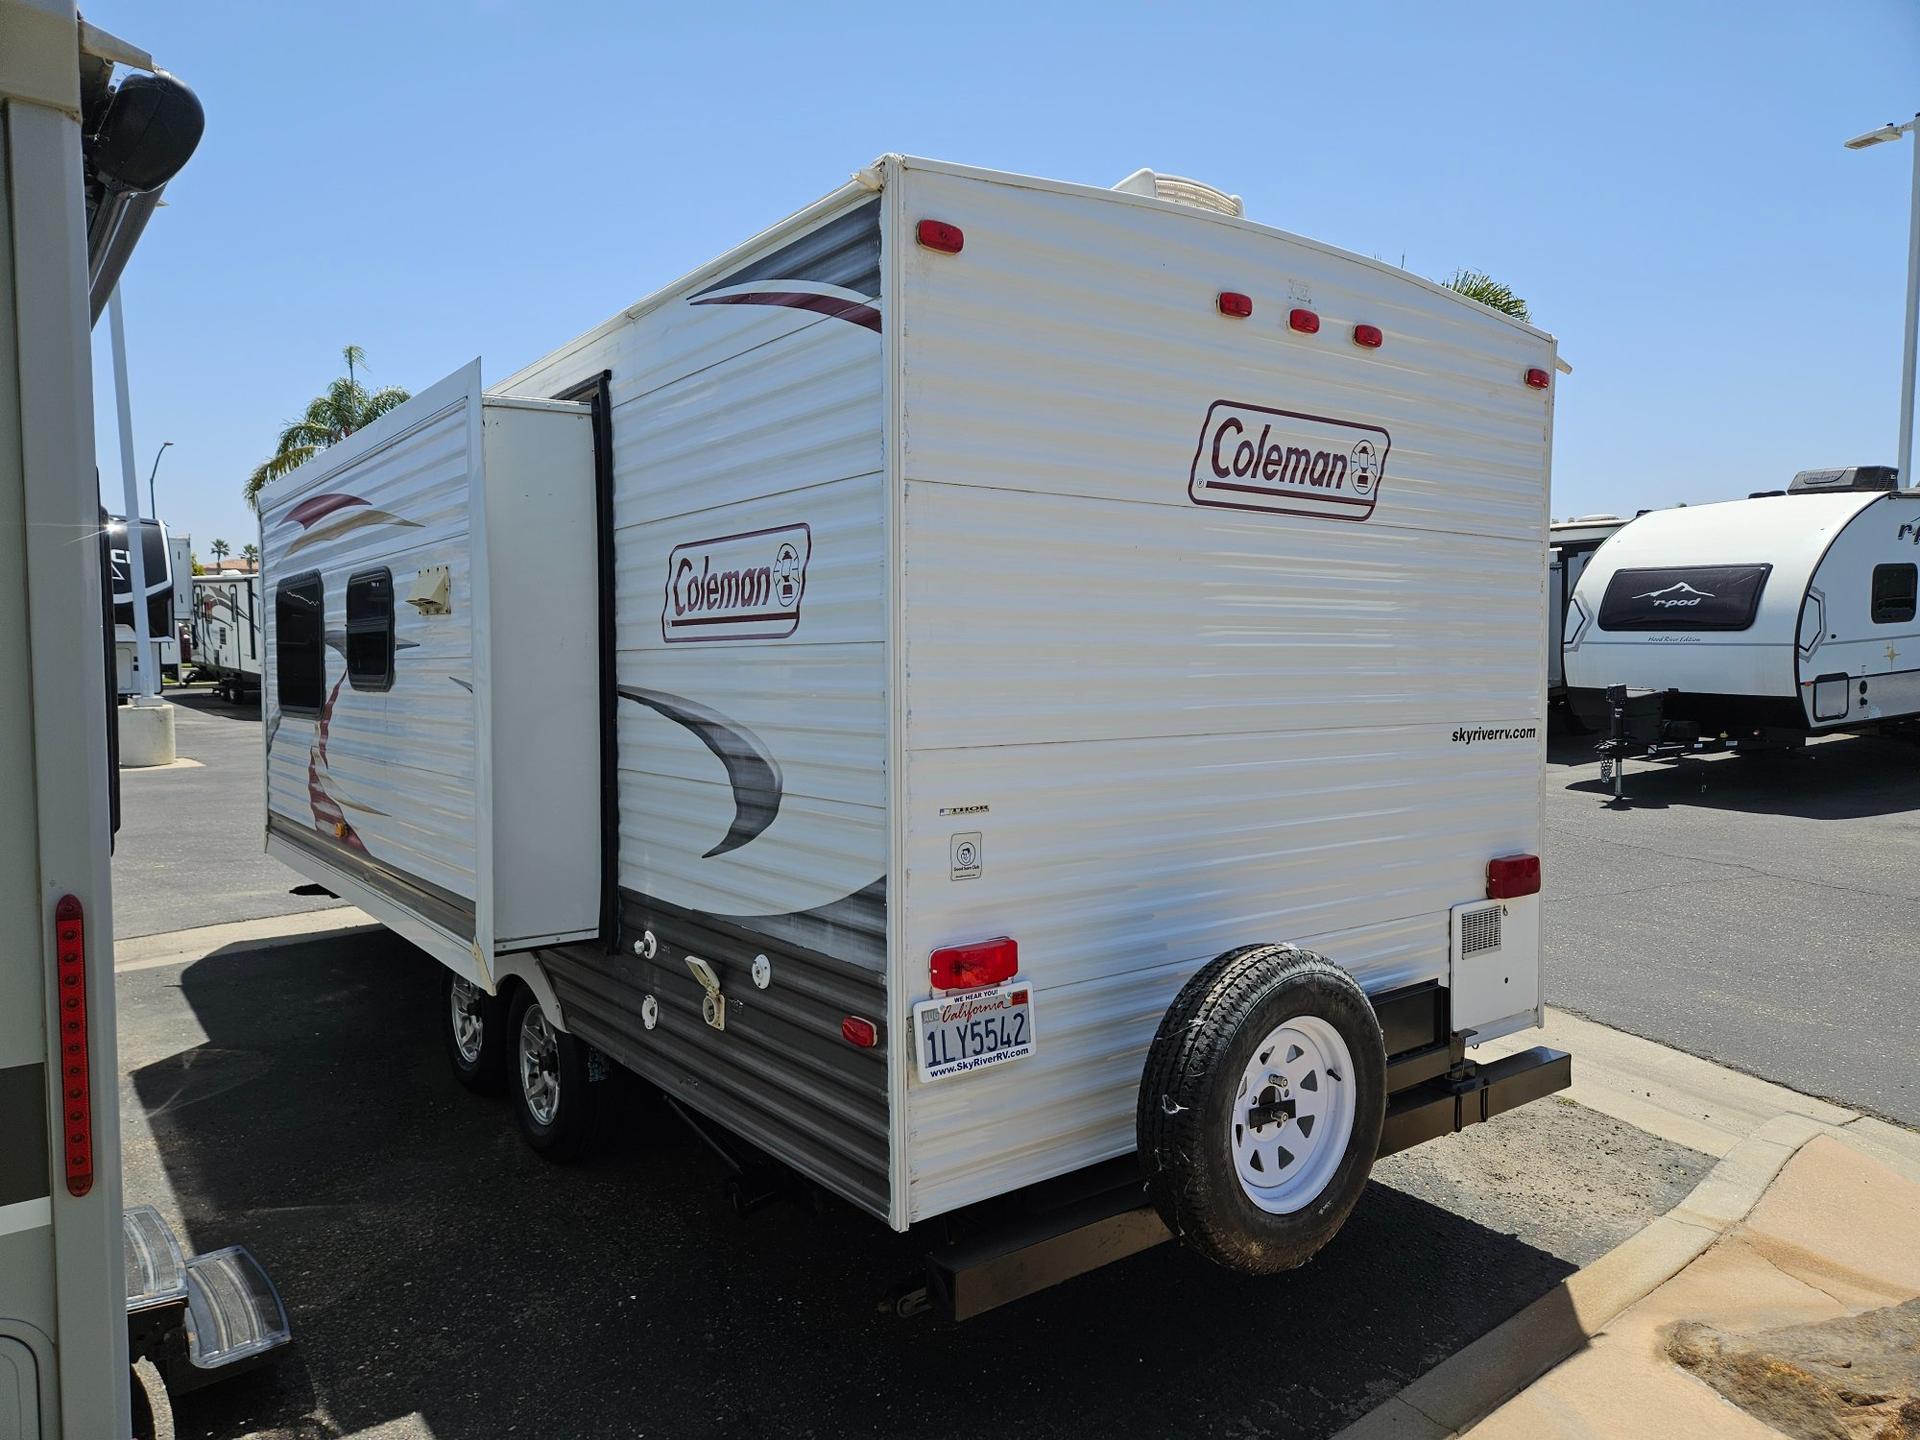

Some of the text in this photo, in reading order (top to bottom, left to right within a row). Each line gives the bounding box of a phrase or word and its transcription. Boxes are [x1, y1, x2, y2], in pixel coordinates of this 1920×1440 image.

[1211, 417, 1347, 489] Coleman
[673, 555, 771, 617] Coleman
[1451, 726, 1536, 746] skyriverrv.com
[942, 1000, 1011, 1023] California
[927, 1012, 1026, 1067] 1LY5542
[930, 1048, 1029, 1077] www.SkyRiverRV.com
